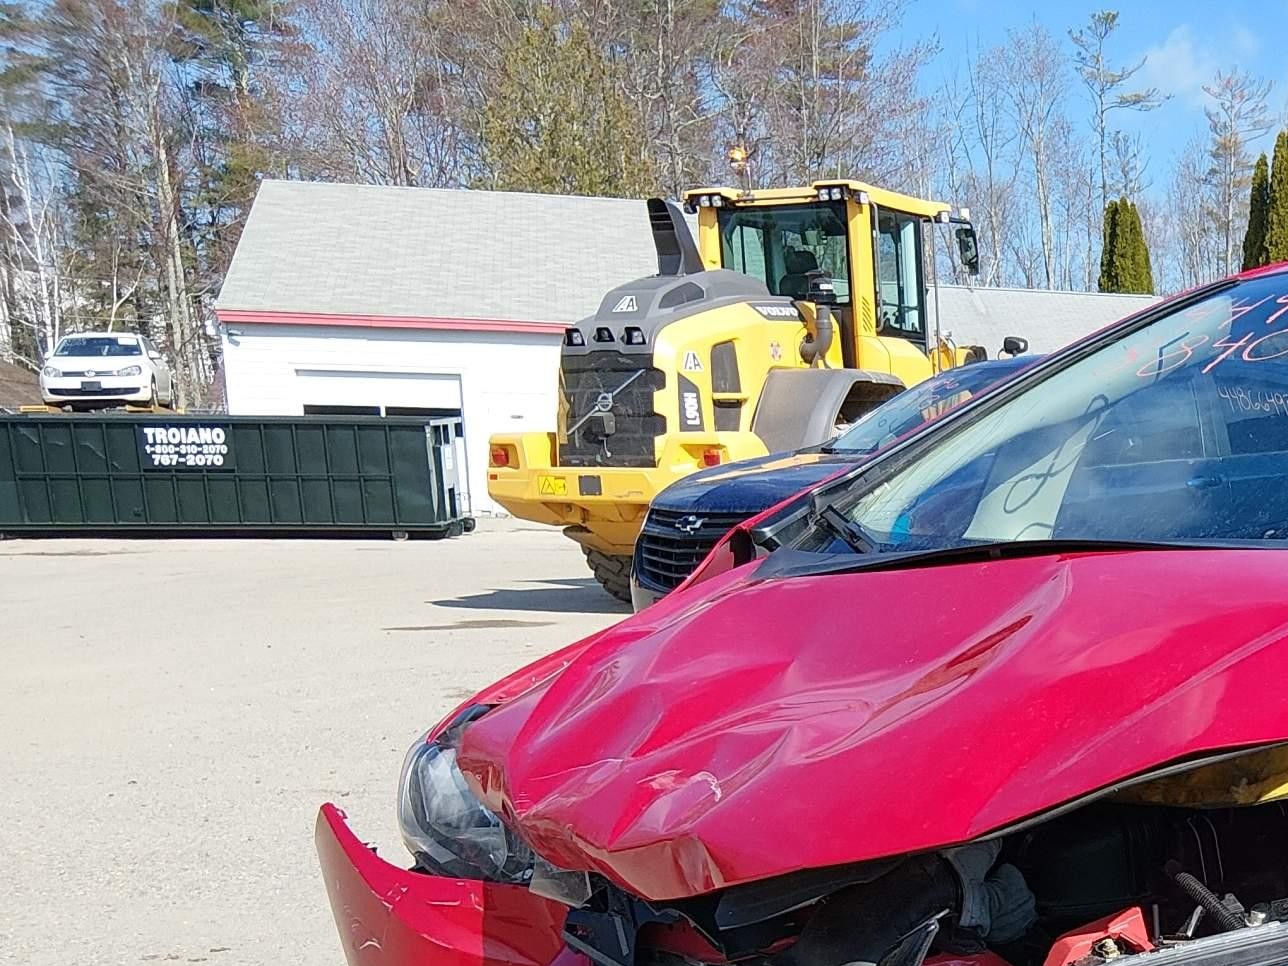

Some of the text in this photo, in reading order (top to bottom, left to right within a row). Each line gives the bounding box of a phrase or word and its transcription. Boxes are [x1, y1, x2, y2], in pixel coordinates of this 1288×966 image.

[755, 306, 799, 317] VOLVO
[683, 392, 700, 425] L90H
[143, 427, 226, 444] TROIANO
[152, 454, 224, 466] 767-2070
